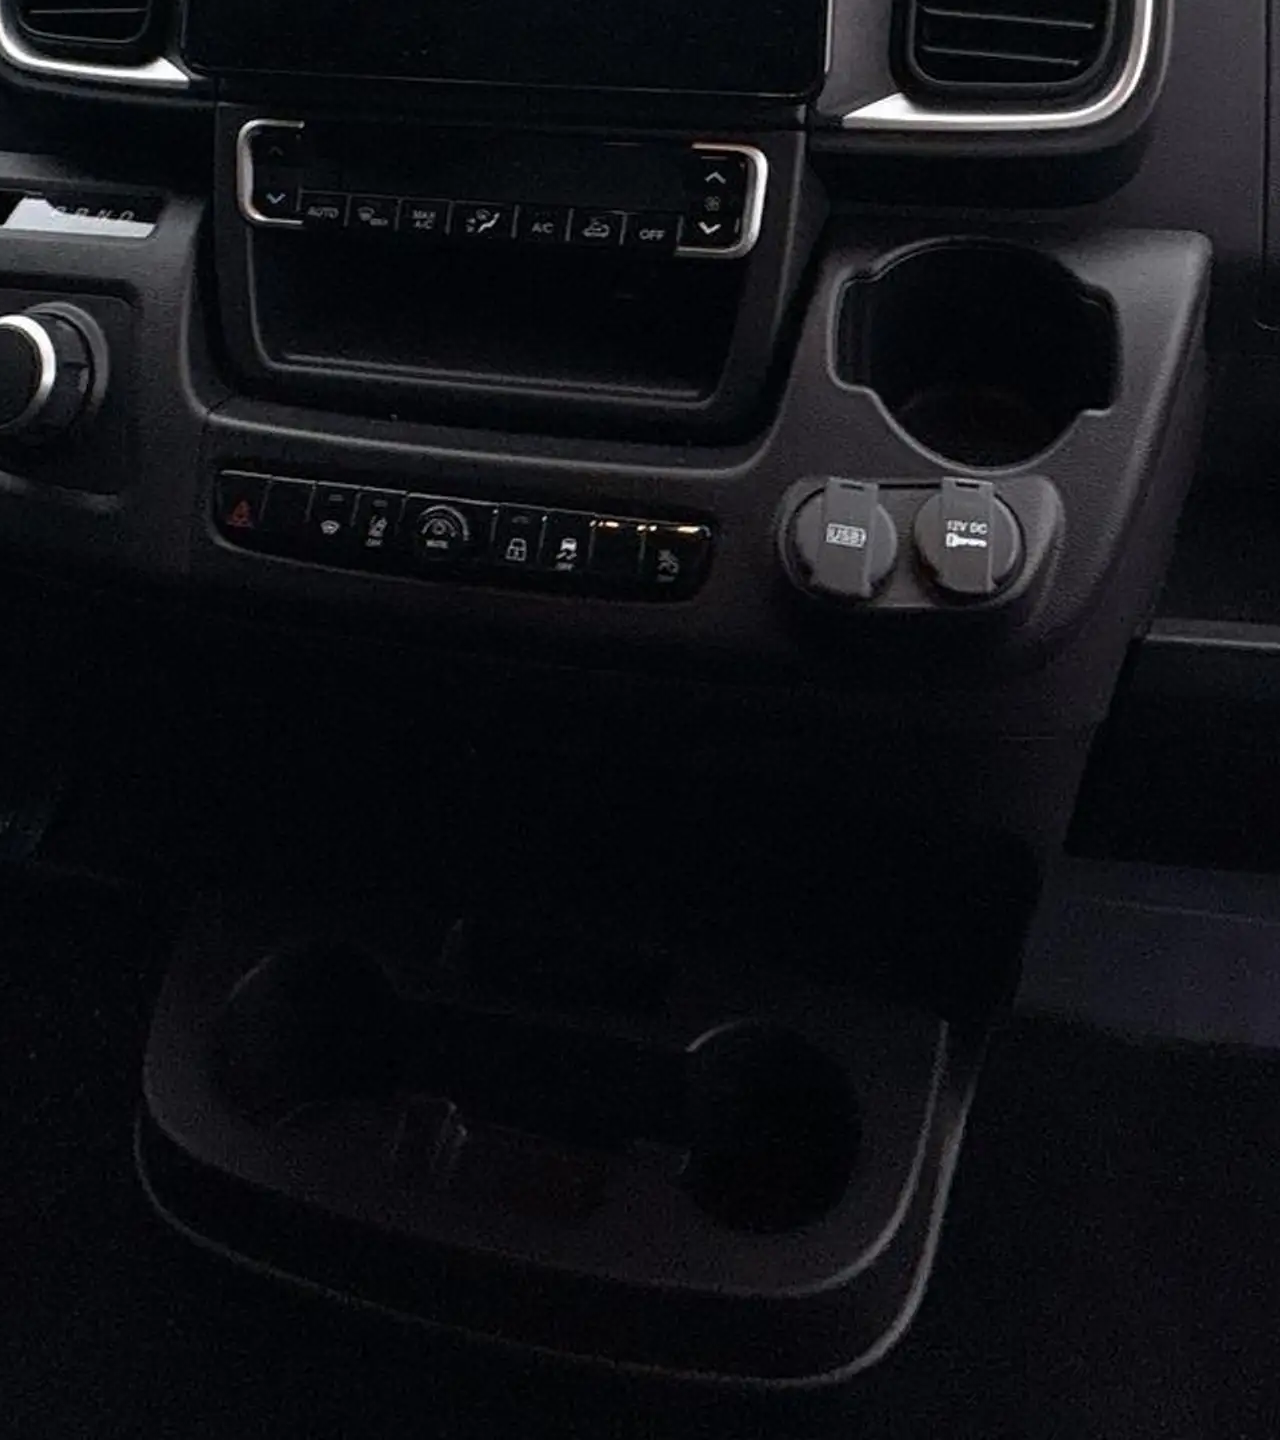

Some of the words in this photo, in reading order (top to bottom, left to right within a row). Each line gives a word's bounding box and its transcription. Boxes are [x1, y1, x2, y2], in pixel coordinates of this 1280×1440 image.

[307, 205, 340, 220] AUTO
[639, 228, 665, 241] OFF
[946, 520, 968, 533] 12V
[969, 521, 989, 535] DC
